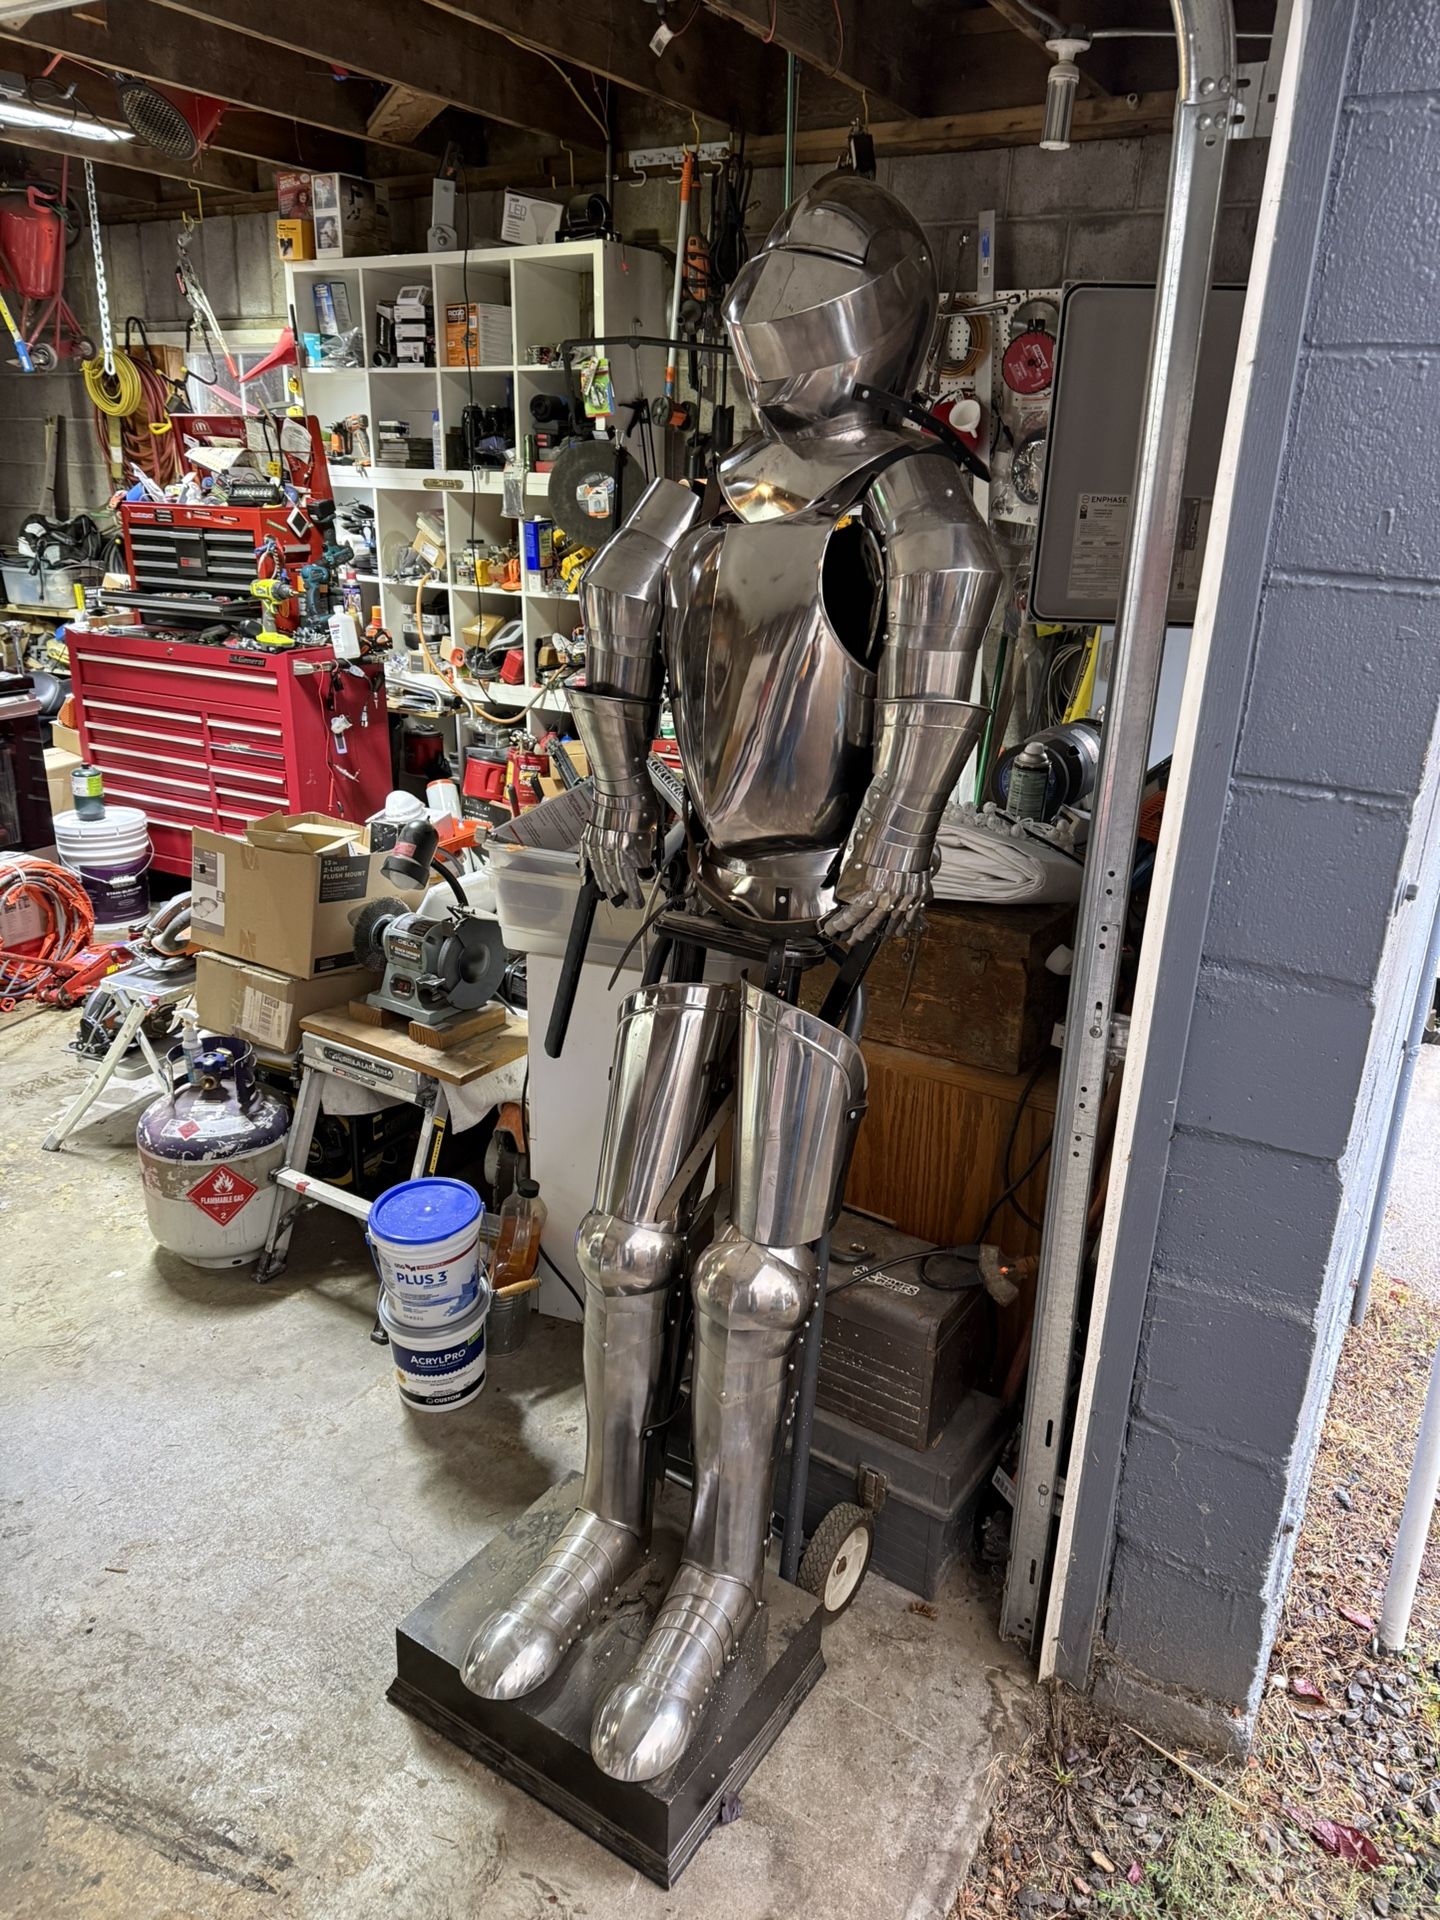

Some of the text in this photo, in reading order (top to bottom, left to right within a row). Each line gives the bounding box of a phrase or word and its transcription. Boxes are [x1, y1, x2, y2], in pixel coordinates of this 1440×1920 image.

[508, 202, 527, 217] LED
[1091, 495, 1128, 504] ENPHASE
[344, 870, 366, 878] MOUNT
[200, 1193, 245, 1205] FLAMMABLE GAS
[396, 1272, 434, 1286] PLUS
[438, 1271, 447, 1282] 3
[434, 1393, 462, 1404] CUSTOM
